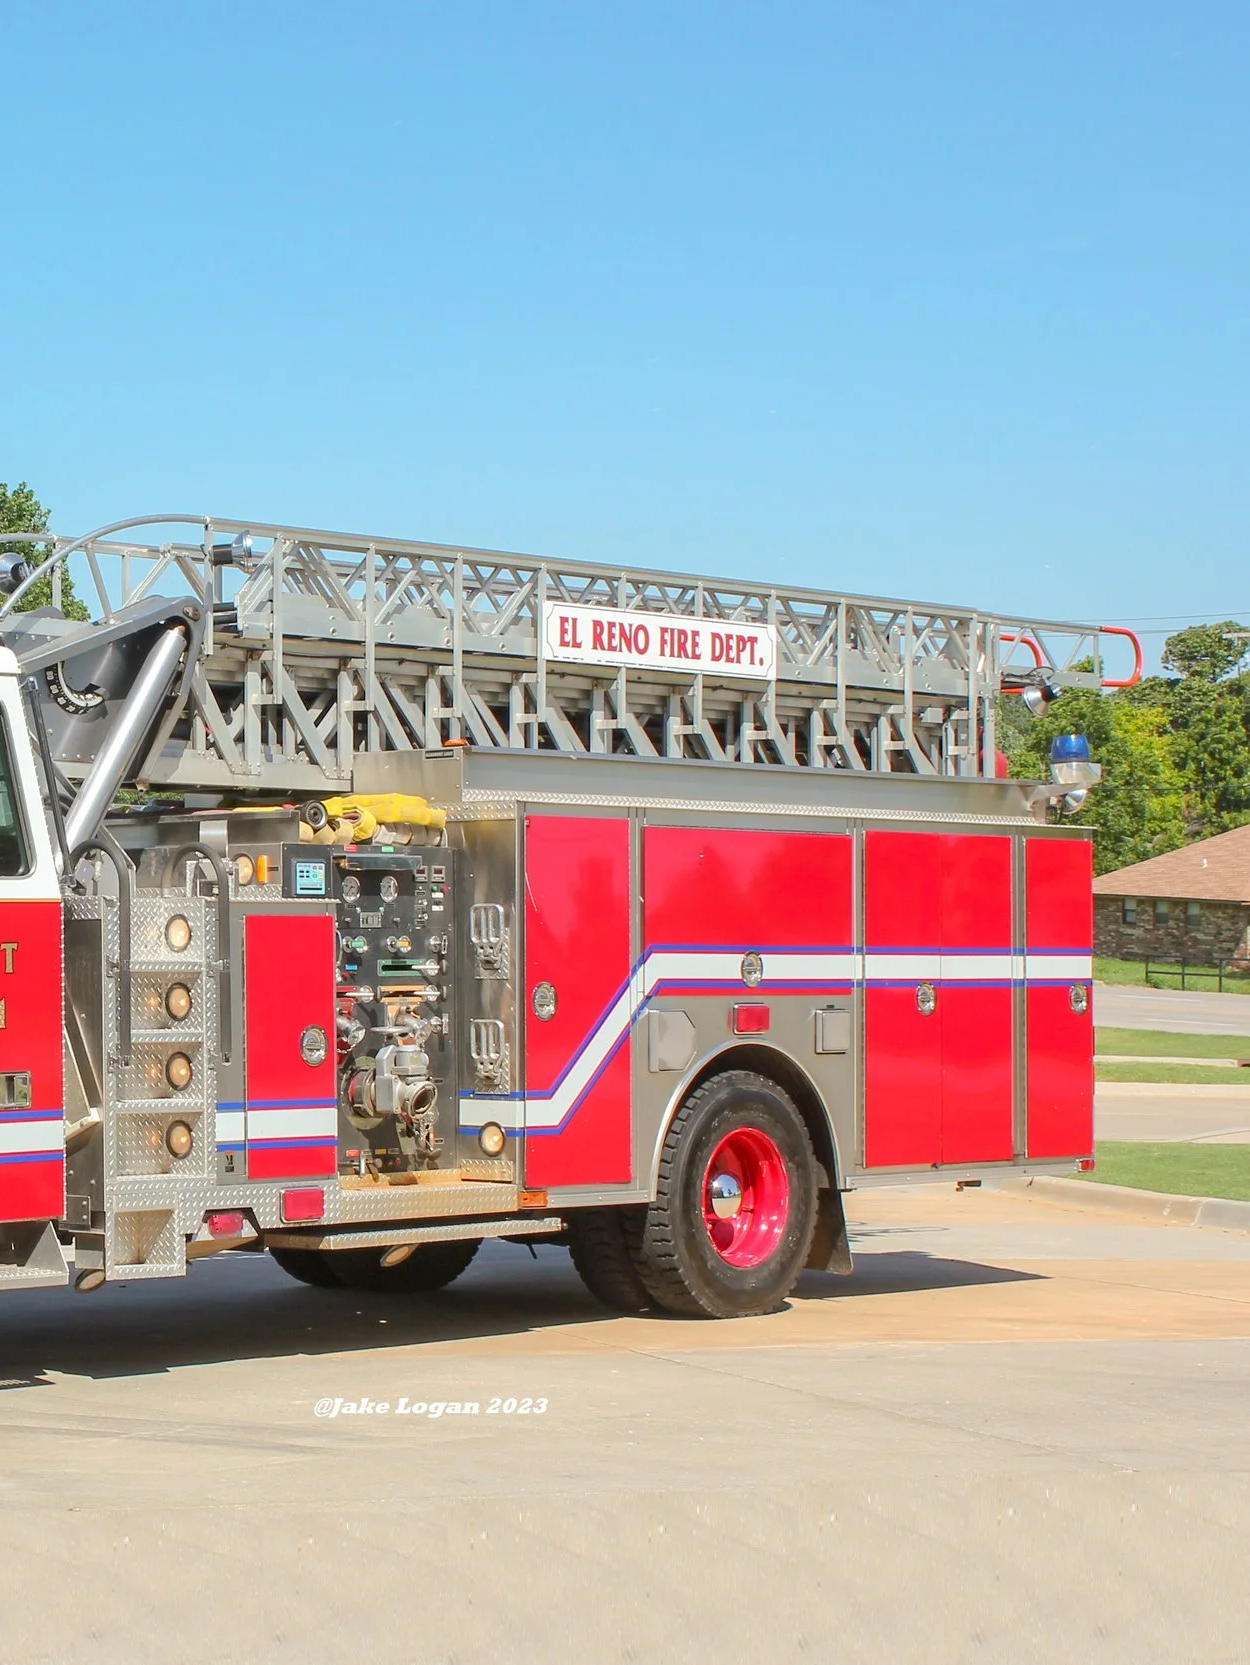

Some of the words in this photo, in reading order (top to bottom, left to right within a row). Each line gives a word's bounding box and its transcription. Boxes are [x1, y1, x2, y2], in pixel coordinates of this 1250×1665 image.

[559, 616, 582, 649] EL
[591, 619, 650, 655] RENO
[659, 627, 702, 660] FIRE
[710, 632, 764, 666] DEPT.
